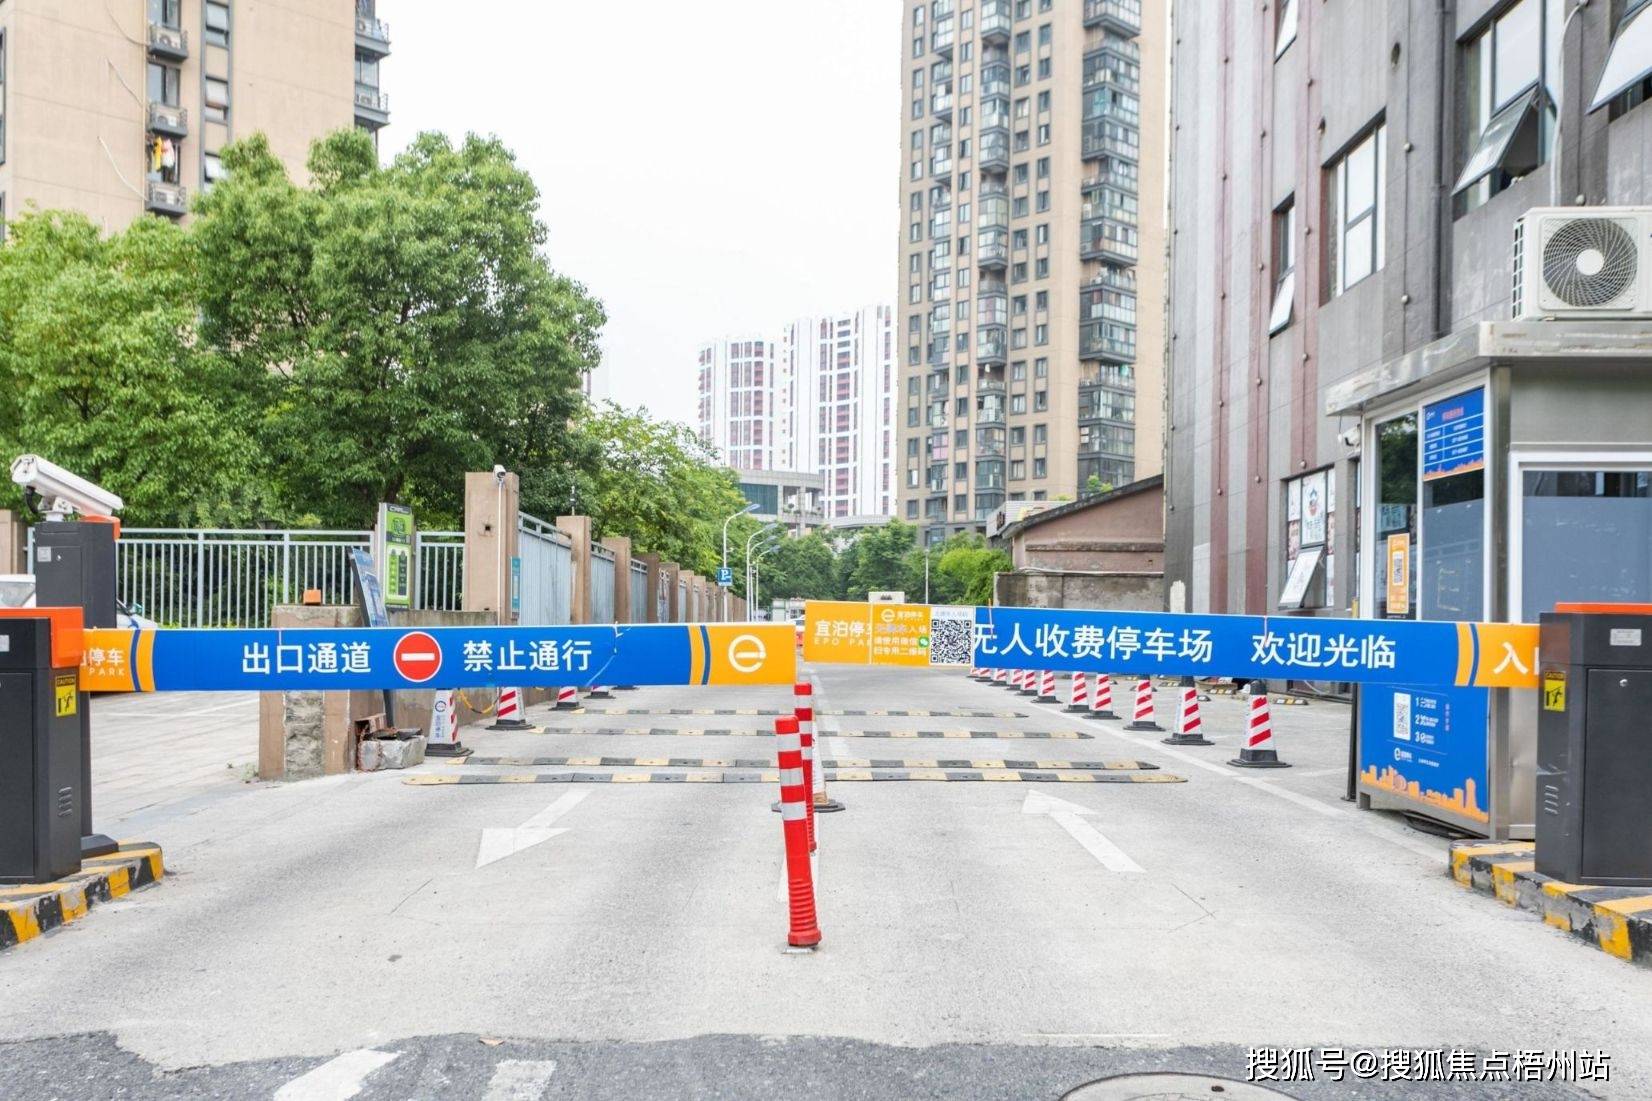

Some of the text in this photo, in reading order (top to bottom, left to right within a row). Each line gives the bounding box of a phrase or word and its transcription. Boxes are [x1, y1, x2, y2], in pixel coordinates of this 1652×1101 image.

[242, 639, 592, 675] 出口通道 禁止通行
[974, 622, 1396, 669] 无人收费停车场 欢迎光临
[1493, 641, 1540, 675] 入
[88, 667, 125, 677] PARK
